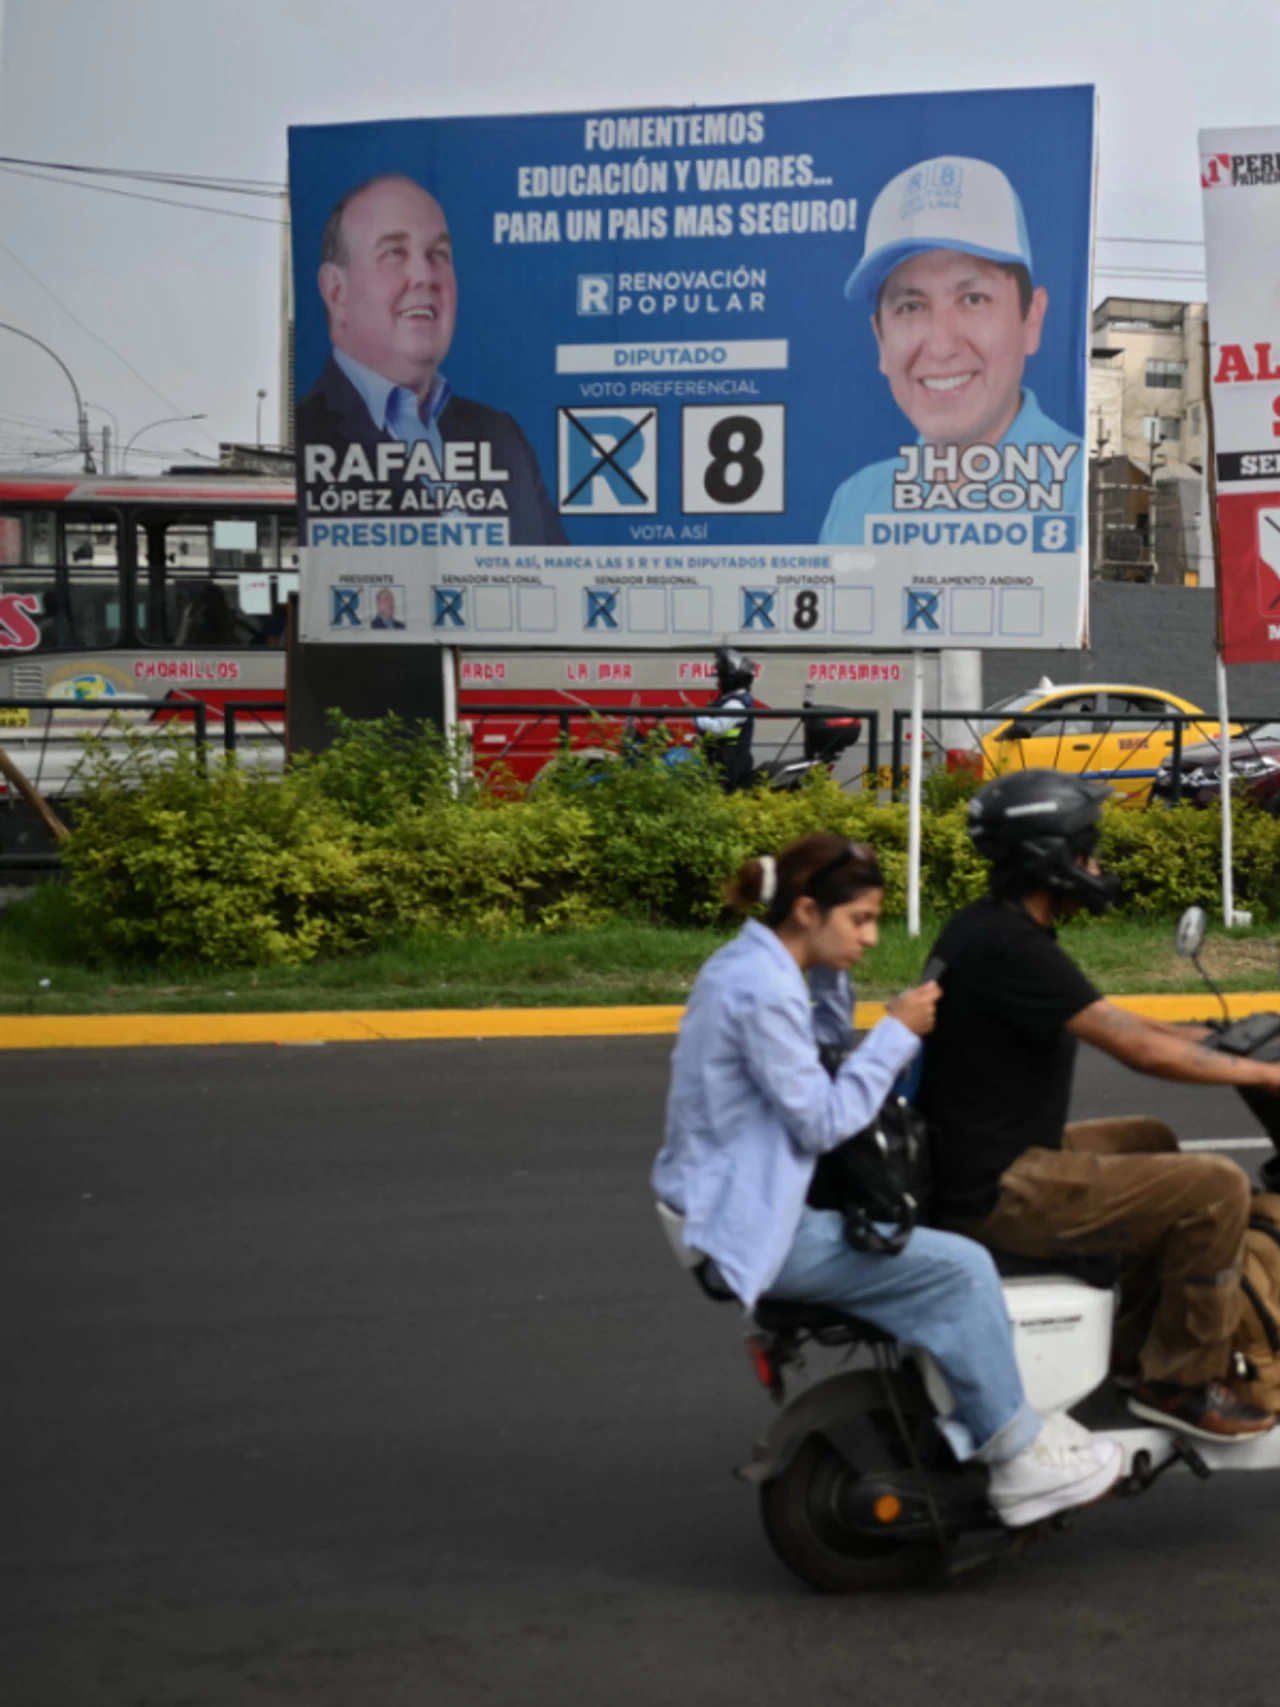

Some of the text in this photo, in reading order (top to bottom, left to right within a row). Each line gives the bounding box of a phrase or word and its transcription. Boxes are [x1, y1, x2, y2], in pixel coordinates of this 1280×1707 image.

[585, 112, 764, 150] FOMENTEMOS
[518, 154, 832, 198] EDUCACIÓN Y VALORES...
[1208, 160, 1221, 182] 1
[494, 199, 857, 243] PARA UN PAIS MAS SEGURO!
[618, 266, 766, 291] RENOVACIÓN
[580, 278, 609, 311] R
[618, 292, 765, 313] POPULAR
[613, 347, 727, 366] DIPUTADO
[580, 379, 760, 397] VOTO PREFERENCIAL
[304, 441, 509, 482] RAFAEL
[568, 415, 764, 506] R 8
[894, 443, 1080, 482] JHONY
[306, 486, 508, 511] LÓPEZ ALIAGA
[893, 482, 1064, 511] BACON
[312, 522, 504, 546] PRESIDENTE
[630, 522, 708, 541] VOTA ASÍ
[872, 519, 1067, 550] DIPUTADO 8
[475, 557, 510, 569] VOTA
[544, 557, 592, 569] MARCA
[597, 557, 622, 569] LAS
[639, 557, 648, 569] R
[651, 557, 662, 569] Y
[665, 557, 684, 569] EN
[688, 556, 766, 569] DIPUTADOS
[771, 556, 831, 569] ESCRIBE
[339, 575, 394, 584] PRESIDENTE
[442, 575, 542, 585] SENADOR NACIONAL
[595, 576, 697, 585] SENADOR REGIONAL
[776, 575, 835, 585] DIPUTADOS
[912, 576, 1034, 585] PARLAMENTO ANDINO
[334, 590, 361, 626] R
[435, 590, 465, 626] R
[585, 590, 618, 628] R
[744, 590, 819, 630] R 8
[907, 592, 939, 630] R
[135, 661, 239, 679] CHORRILLOS
[567, 663, 632, 680] LA MAR
[809, 664, 900, 681] PACASMAYO
